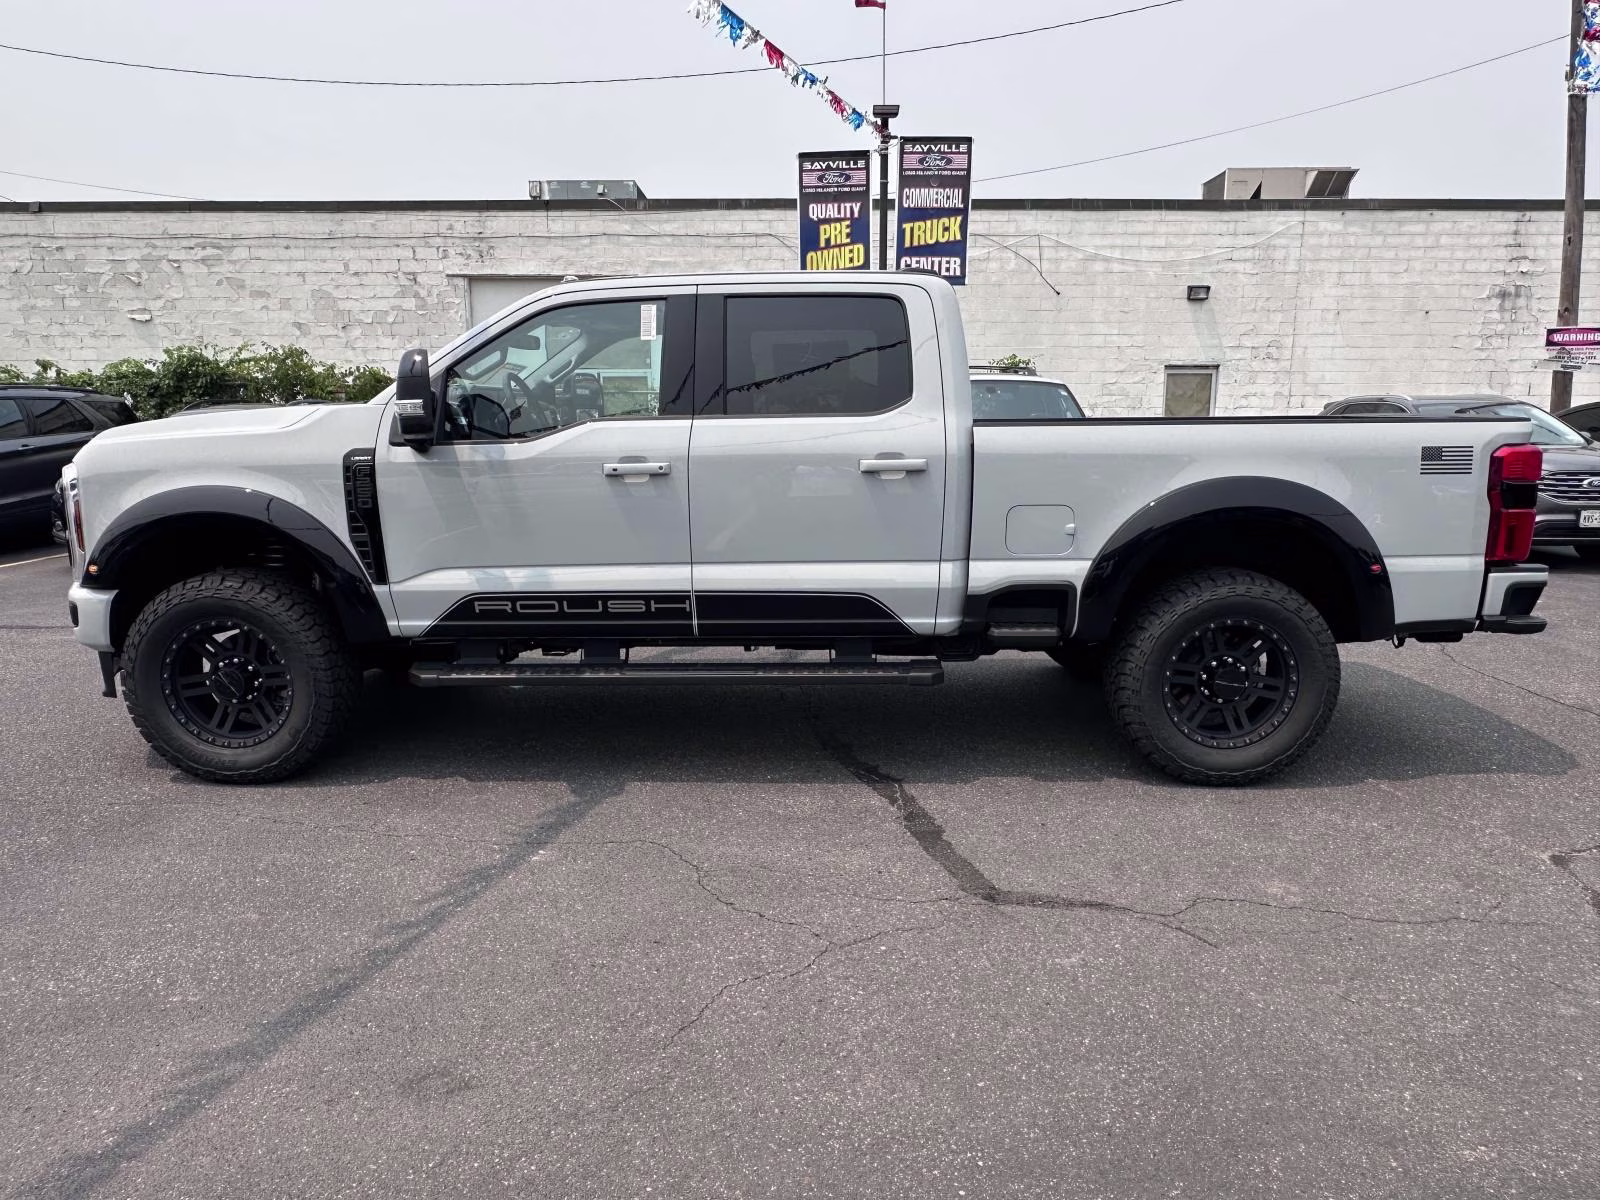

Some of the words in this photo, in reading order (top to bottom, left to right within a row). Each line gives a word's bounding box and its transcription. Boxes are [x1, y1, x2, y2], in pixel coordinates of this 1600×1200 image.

[903, 144, 968, 152] SAYVILLE
[802, 160, 866, 170] SAYVILLE
[922, 154, 948, 167] Ford
[822, 173, 846, 184] Ford
[902, 188, 964, 208] COMMERCIAL
[808, 201, 861, 220] QUALITY
[819, 221, 852, 247] PRE
[902, 215, 963, 248] TRUCK
[806, 243, 865, 270] OWNED
[474, 600, 690, 613] ROUSH
